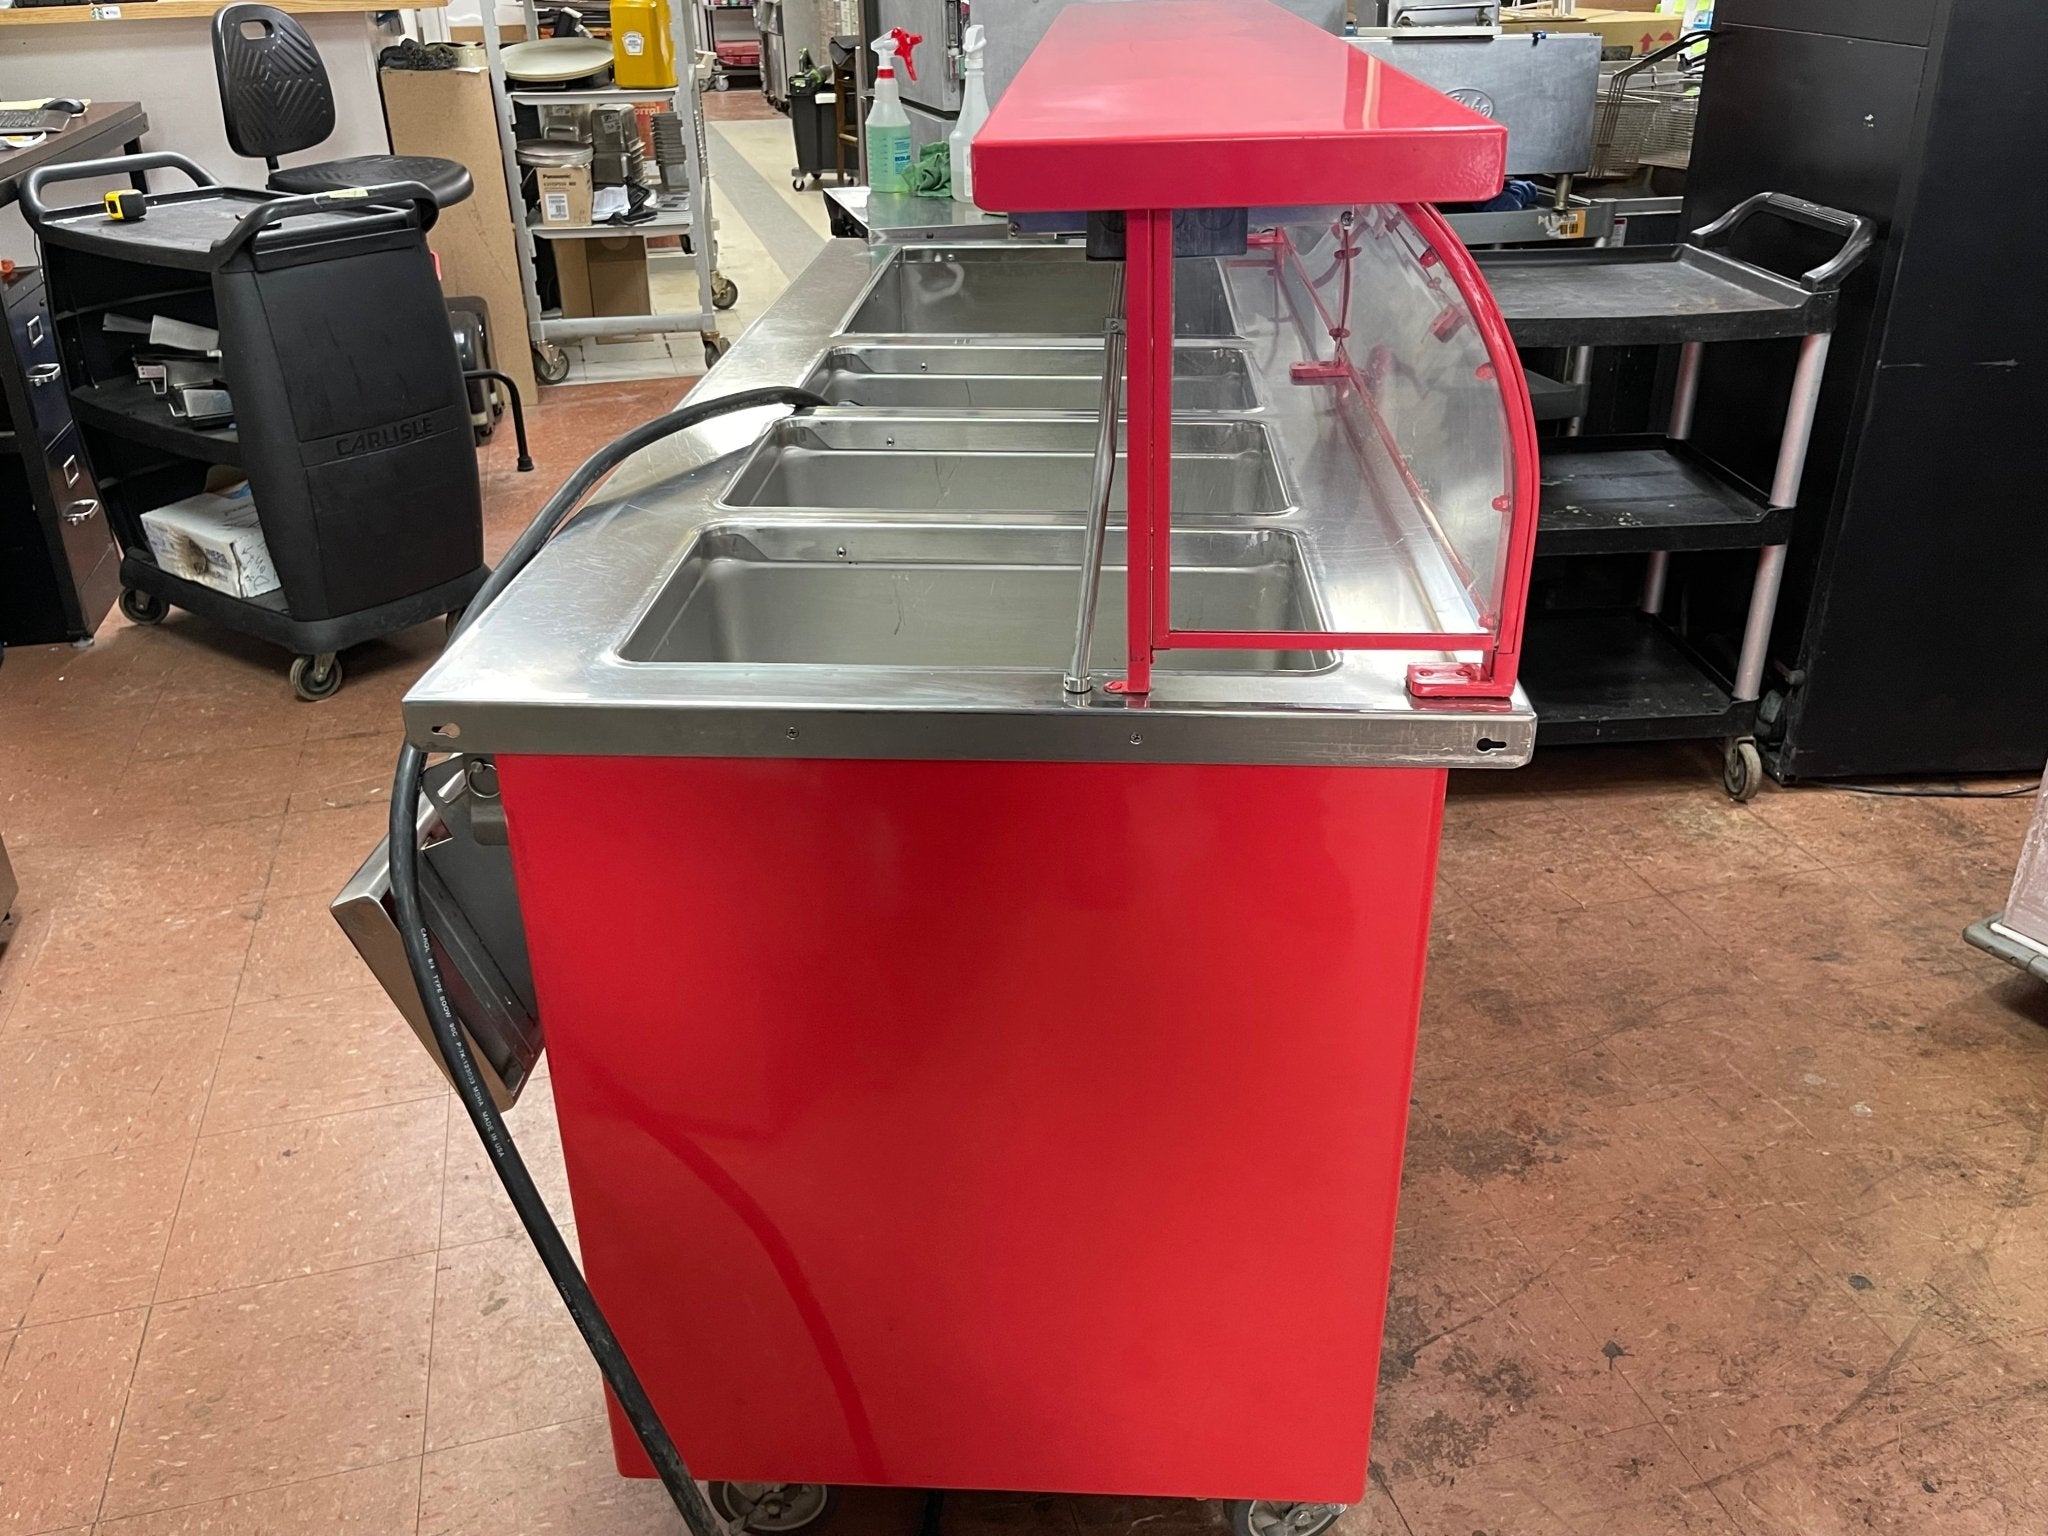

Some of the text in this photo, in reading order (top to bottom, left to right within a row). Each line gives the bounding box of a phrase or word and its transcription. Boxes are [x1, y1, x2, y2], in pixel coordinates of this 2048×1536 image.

[335, 417, 433, 456] CARLISLE
[420, 927, 431, 954] CAROL
[433, 974, 443, 994] TYPE
[481, 1110, 495, 1132] MADE
[494, 1142, 505, 1158] USA
